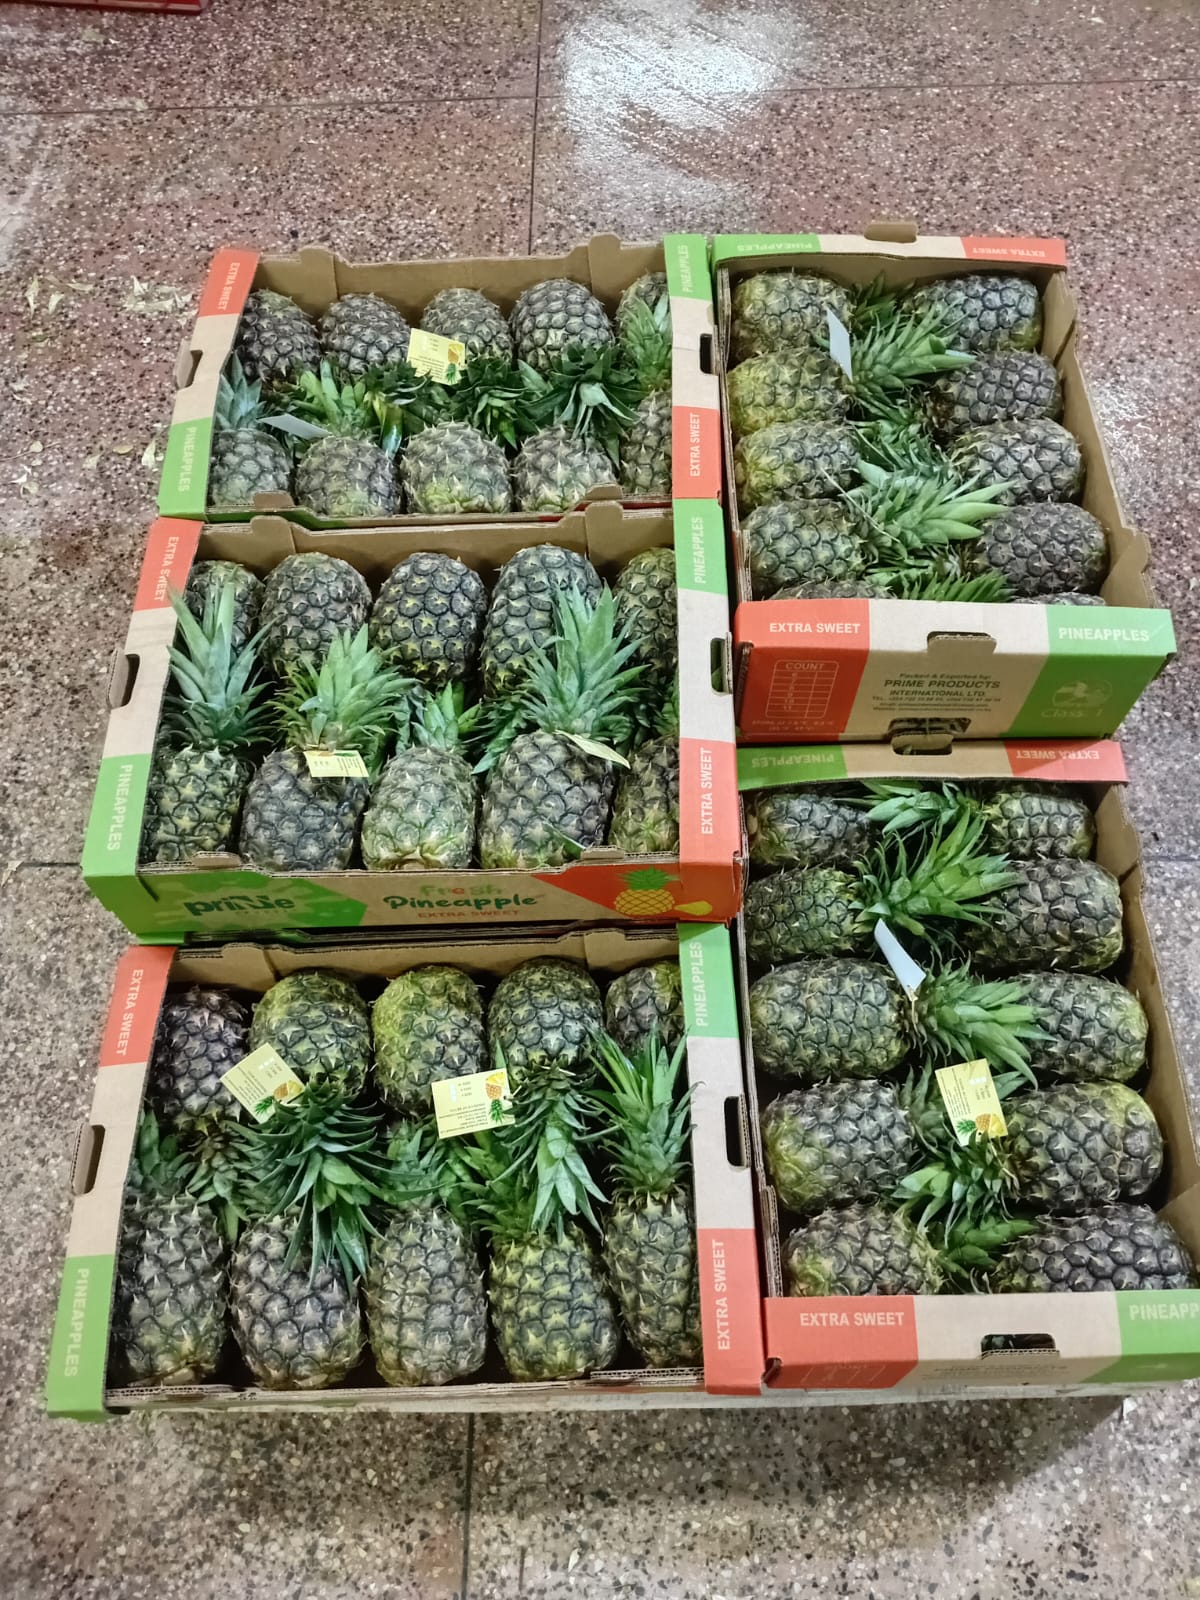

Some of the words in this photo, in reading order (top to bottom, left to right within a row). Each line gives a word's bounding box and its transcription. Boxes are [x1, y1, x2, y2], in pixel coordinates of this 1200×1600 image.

[736, 243, 813, 252] PINEAPPLES
[972, 247, 1009, 255] SWEET
[1010, 248, 1046, 257] EXTRA
[225, 262, 241, 286] EXTRA
[677, 244, 694, 293] PINEAPPLES
[217, 286, 233, 311] SWEET
[689, 412, 700, 443] SWEET
[178, 426, 198, 492] PINEAPPLES
[689, 446, 700, 477] EXTRA
[162, 536, 180, 567] EXTRA
[691, 516, 706, 584] PINEAPPLES
[769, 623, 812, 633] EXTRA
[816, 623, 861, 634] SWEET
[1058, 627, 1150, 641] PINEAPPLES
[785, 662, 825, 670] COUNT
[884, 679, 925, 687] PRIME
[928, 680, 1001, 688] PRODUCTS
[751, 753, 835, 768] PINEAPPLES
[1016, 749, 1056, 760] SWEET
[1059, 750, 1100, 760] EXTRA
[700, 747, 712, 789] SWEET
[107, 764, 134, 851] PINEAPPLES
[701, 793, 713, 835] EXTRA
[383, 893, 540, 910] Pineapple
[420, 884, 503, 896] Fresh
[418, 911, 465, 919] EXTRA
[470, 909, 520, 917] SWEET
[125, 969, 144, 1010] EXTRA
[689, 941, 709, 1027] PINEAPPLES
[116, 1012, 134, 1056] SWEET
[712, 1239, 728, 1292] SWEET
[64, 1267, 90, 1377] PINEAPPLES
[715, 1297, 731, 1351] EXTRA
[800, 1312, 850, 1326] EXTRA
[854, 1311, 905, 1326] SWEET
